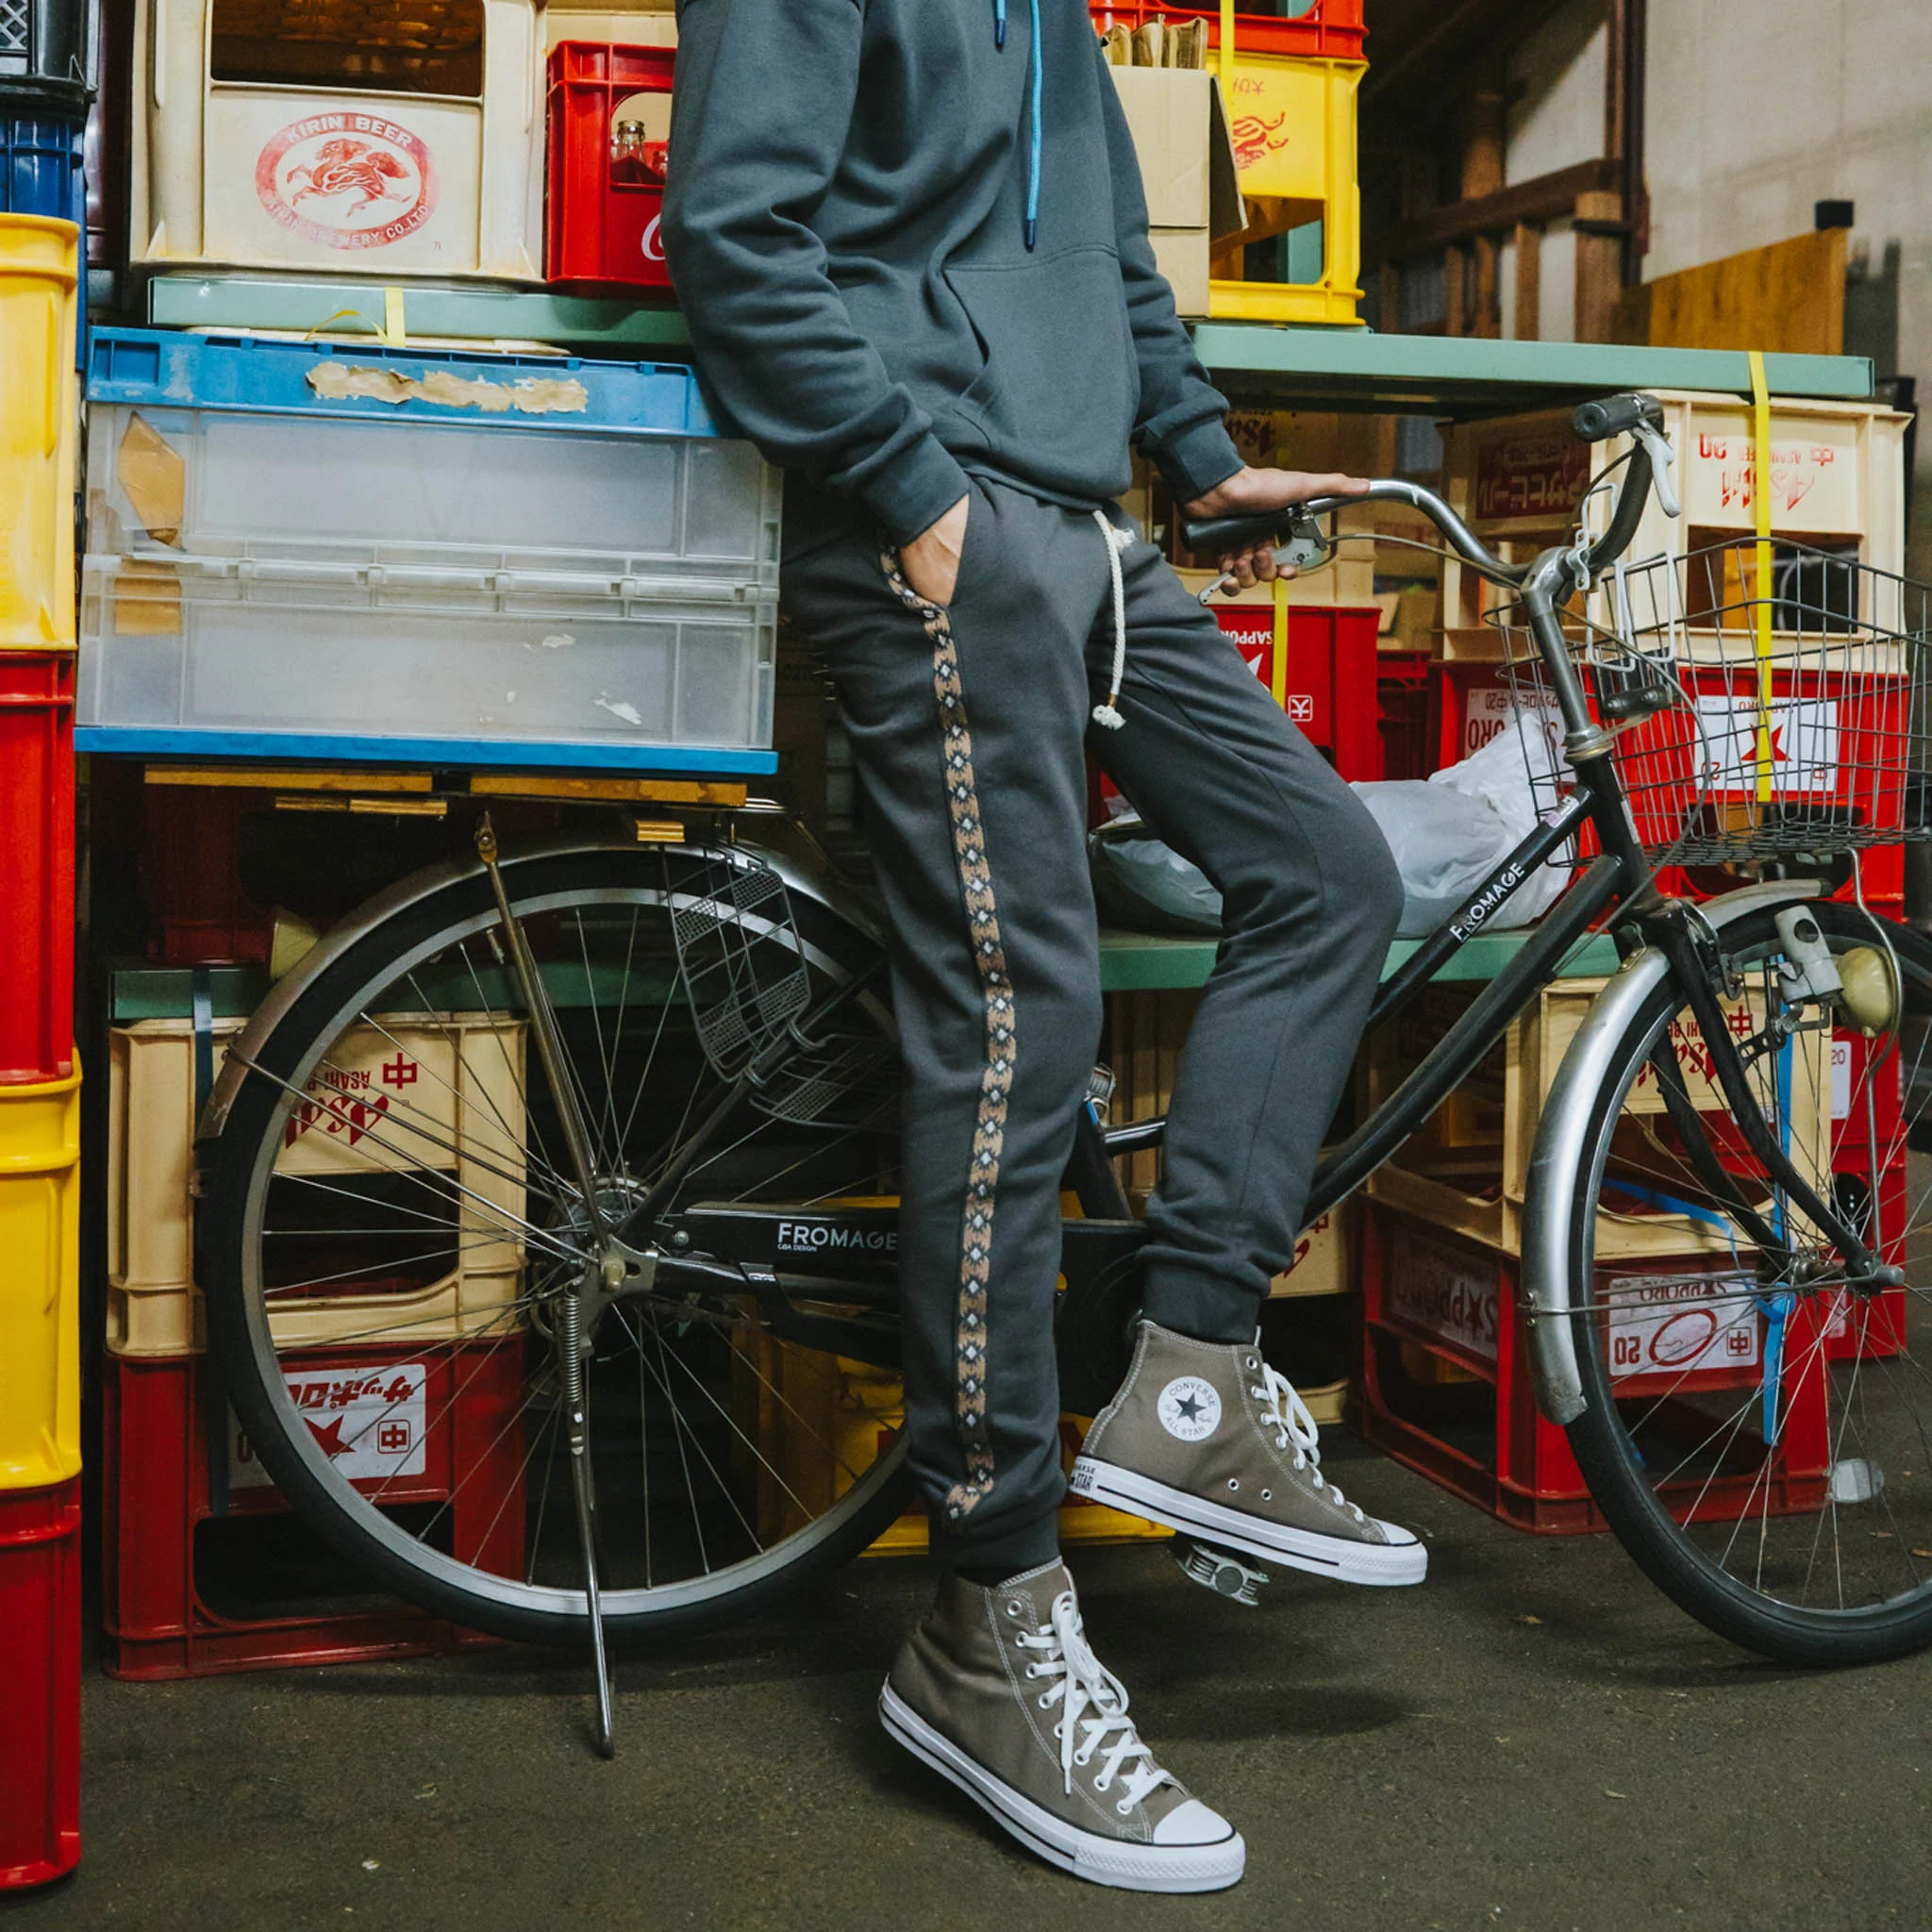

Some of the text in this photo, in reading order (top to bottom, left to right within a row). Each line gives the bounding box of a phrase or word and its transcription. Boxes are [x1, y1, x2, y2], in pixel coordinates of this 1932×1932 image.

[286, 116, 413, 146] KIRIN BEER
[1221, 630, 1274, 645] SAPPO
[1449, 861, 1525, 942] FROMAGE
[1728, 1005, 1754, 1037] 中
[382, 1052, 417, 1090] 中
[286, 1094, 389, 1149] Asa
[777, 1222, 898, 1251] FROMAGE
[1614, 1329, 1750, 1365] 中 20
[287, 1375, 415, 1409] サッポロ
[380, 1424, 408, 1450] 中
